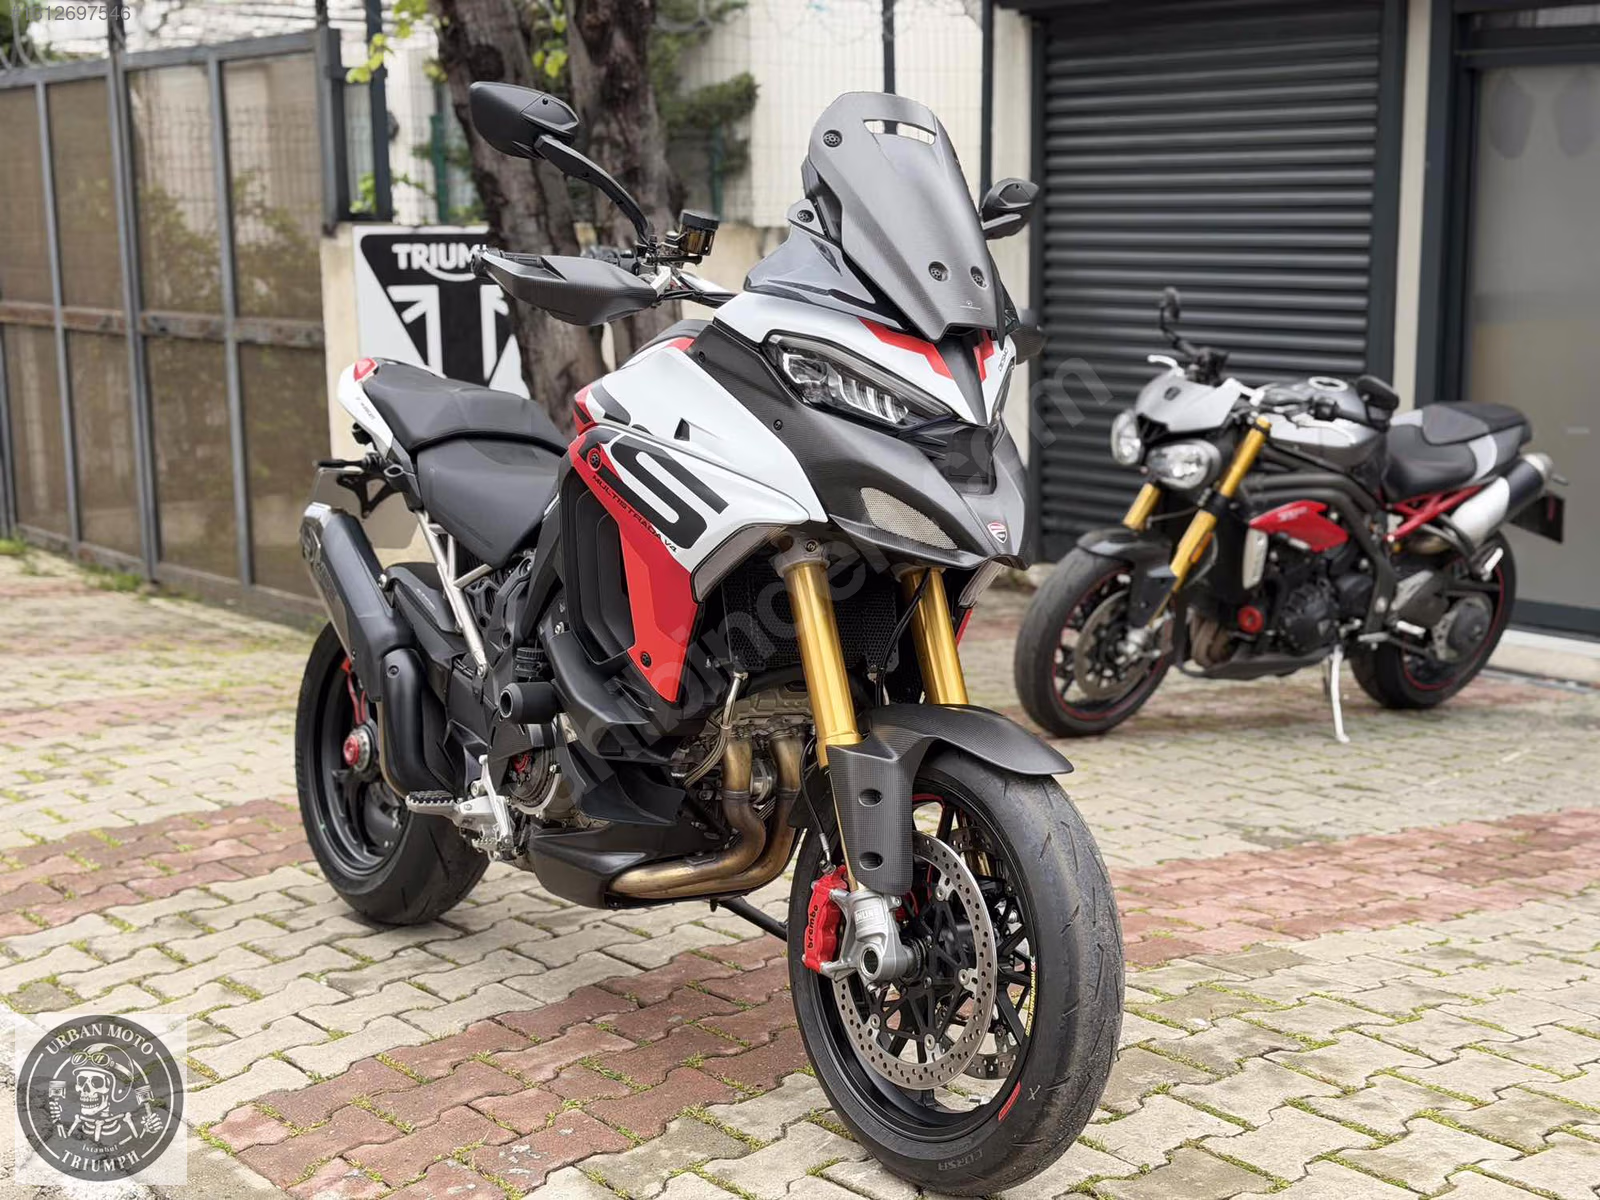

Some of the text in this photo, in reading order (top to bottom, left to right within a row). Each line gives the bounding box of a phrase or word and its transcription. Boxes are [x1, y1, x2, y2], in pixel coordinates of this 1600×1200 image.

[391, 242, 487, 282] TRIUM
[591, 474, 678, 553] MULTISTRADA V4
[807, 904, 819, 949] brembo
